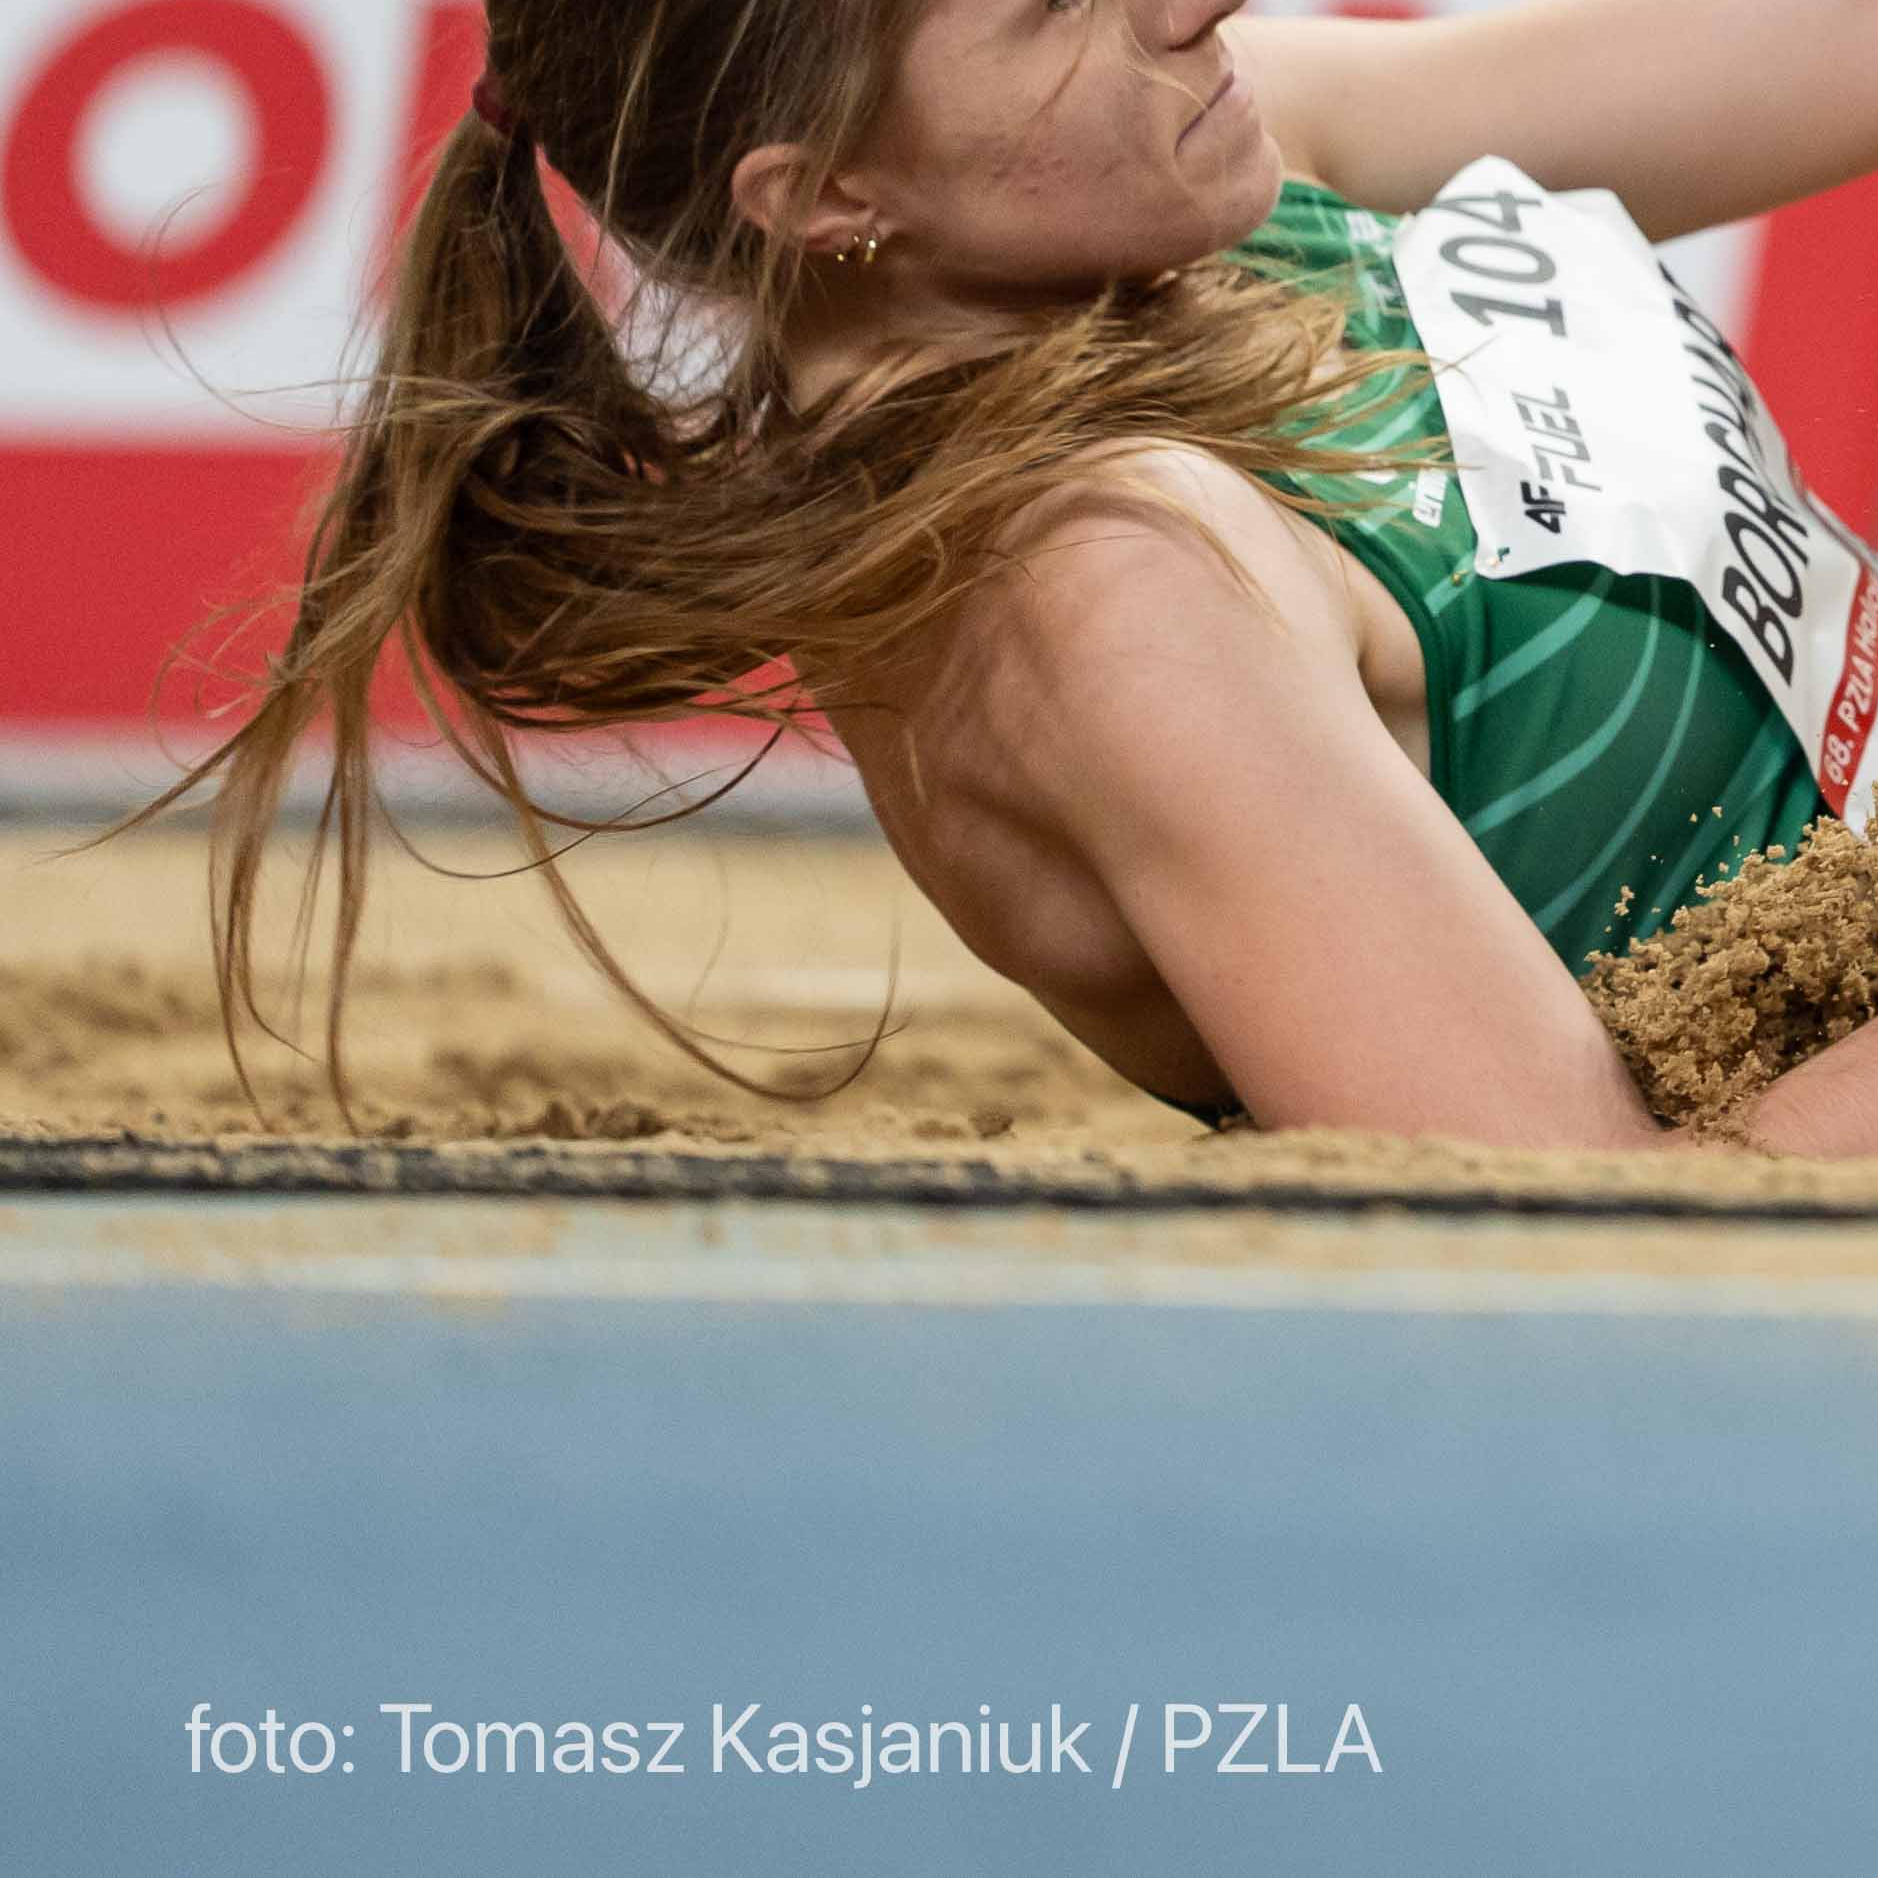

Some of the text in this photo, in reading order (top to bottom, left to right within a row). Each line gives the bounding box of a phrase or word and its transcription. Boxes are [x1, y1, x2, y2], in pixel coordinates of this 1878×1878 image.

[1431, 189, 1567, 339] 104
[1511, 385, 1604, 492] FUEL
[1837, 653, 1875, 733] PZLA
[1823, 732, 1856, 786] 68.
